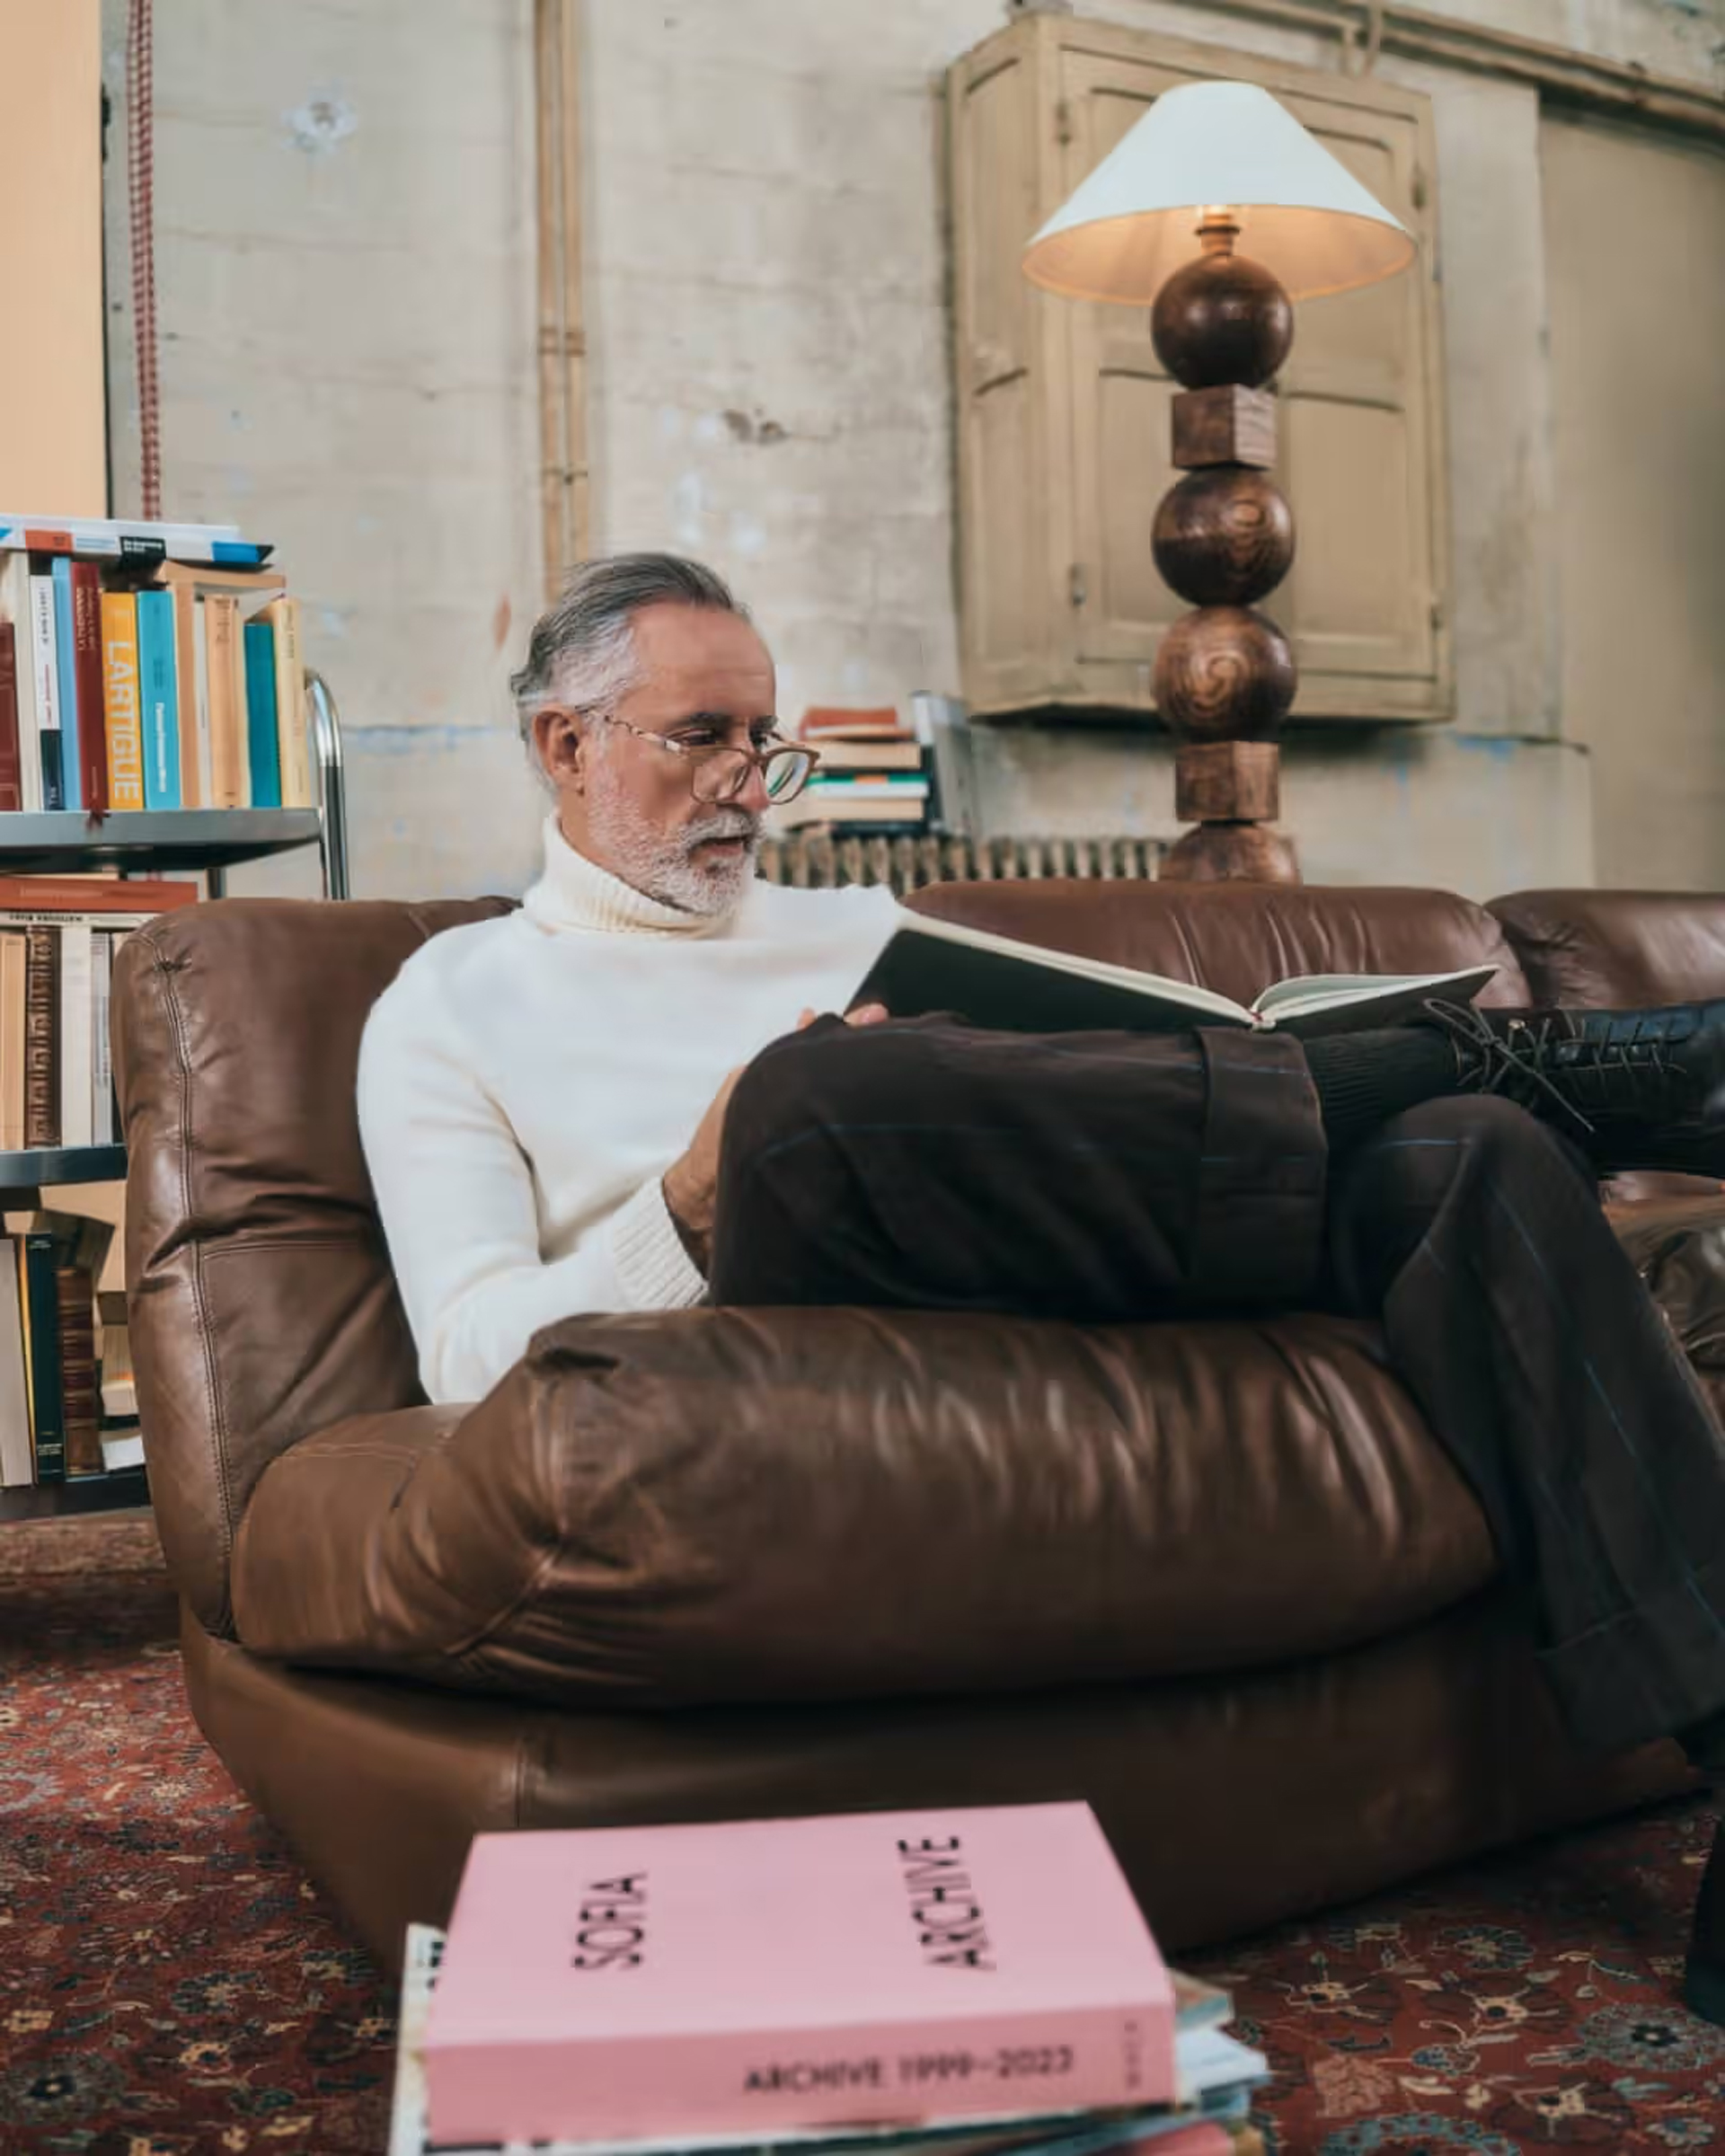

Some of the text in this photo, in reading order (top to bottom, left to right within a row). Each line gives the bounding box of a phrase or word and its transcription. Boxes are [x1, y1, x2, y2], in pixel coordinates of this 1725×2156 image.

[108, 641, 142, 800] LARTIGUE
[573, 1871, 648, 1969] SOFIA
[897, 1836, 997, 1972] ARCHIVE
[745, 2055, 889, 2094] ARCHIVE
